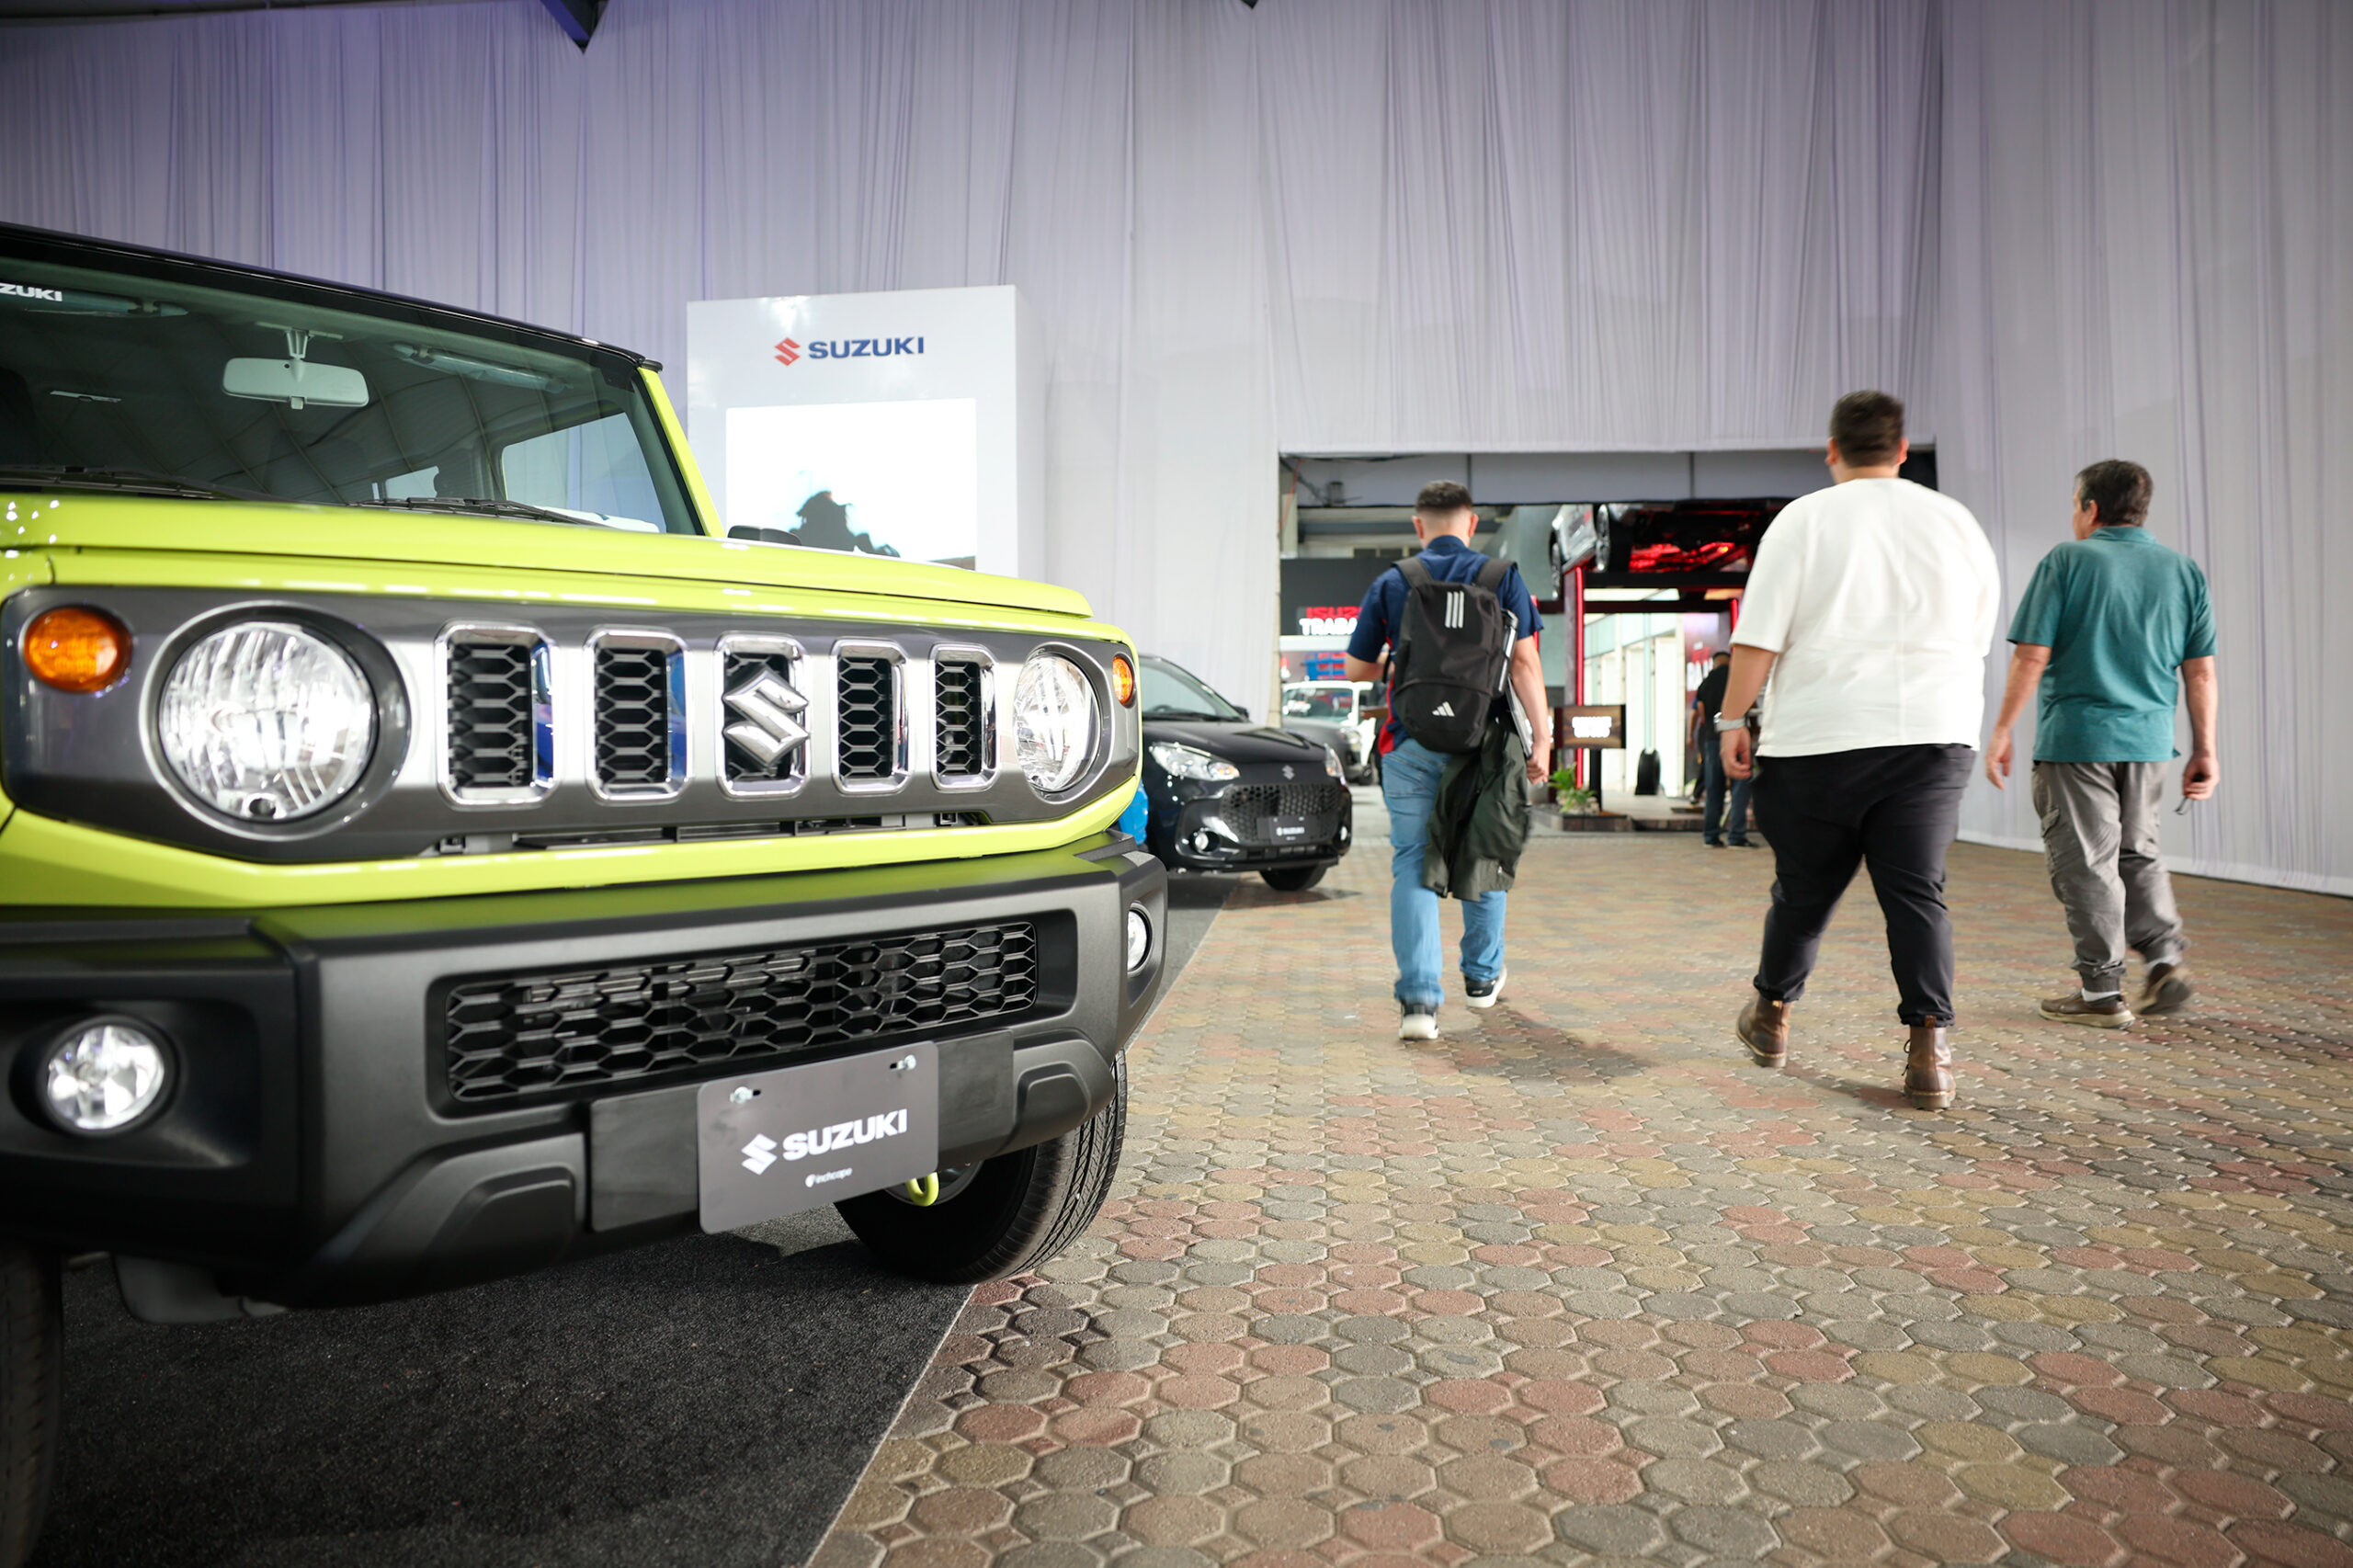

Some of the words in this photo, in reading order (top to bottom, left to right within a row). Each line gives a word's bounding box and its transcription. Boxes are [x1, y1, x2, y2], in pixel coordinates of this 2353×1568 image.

[808, 336, 925, 359] SUZUKI
[1306, 606, 1362, 619] ISUZ
[782, 1108, 908, 1161] SUZUKI
